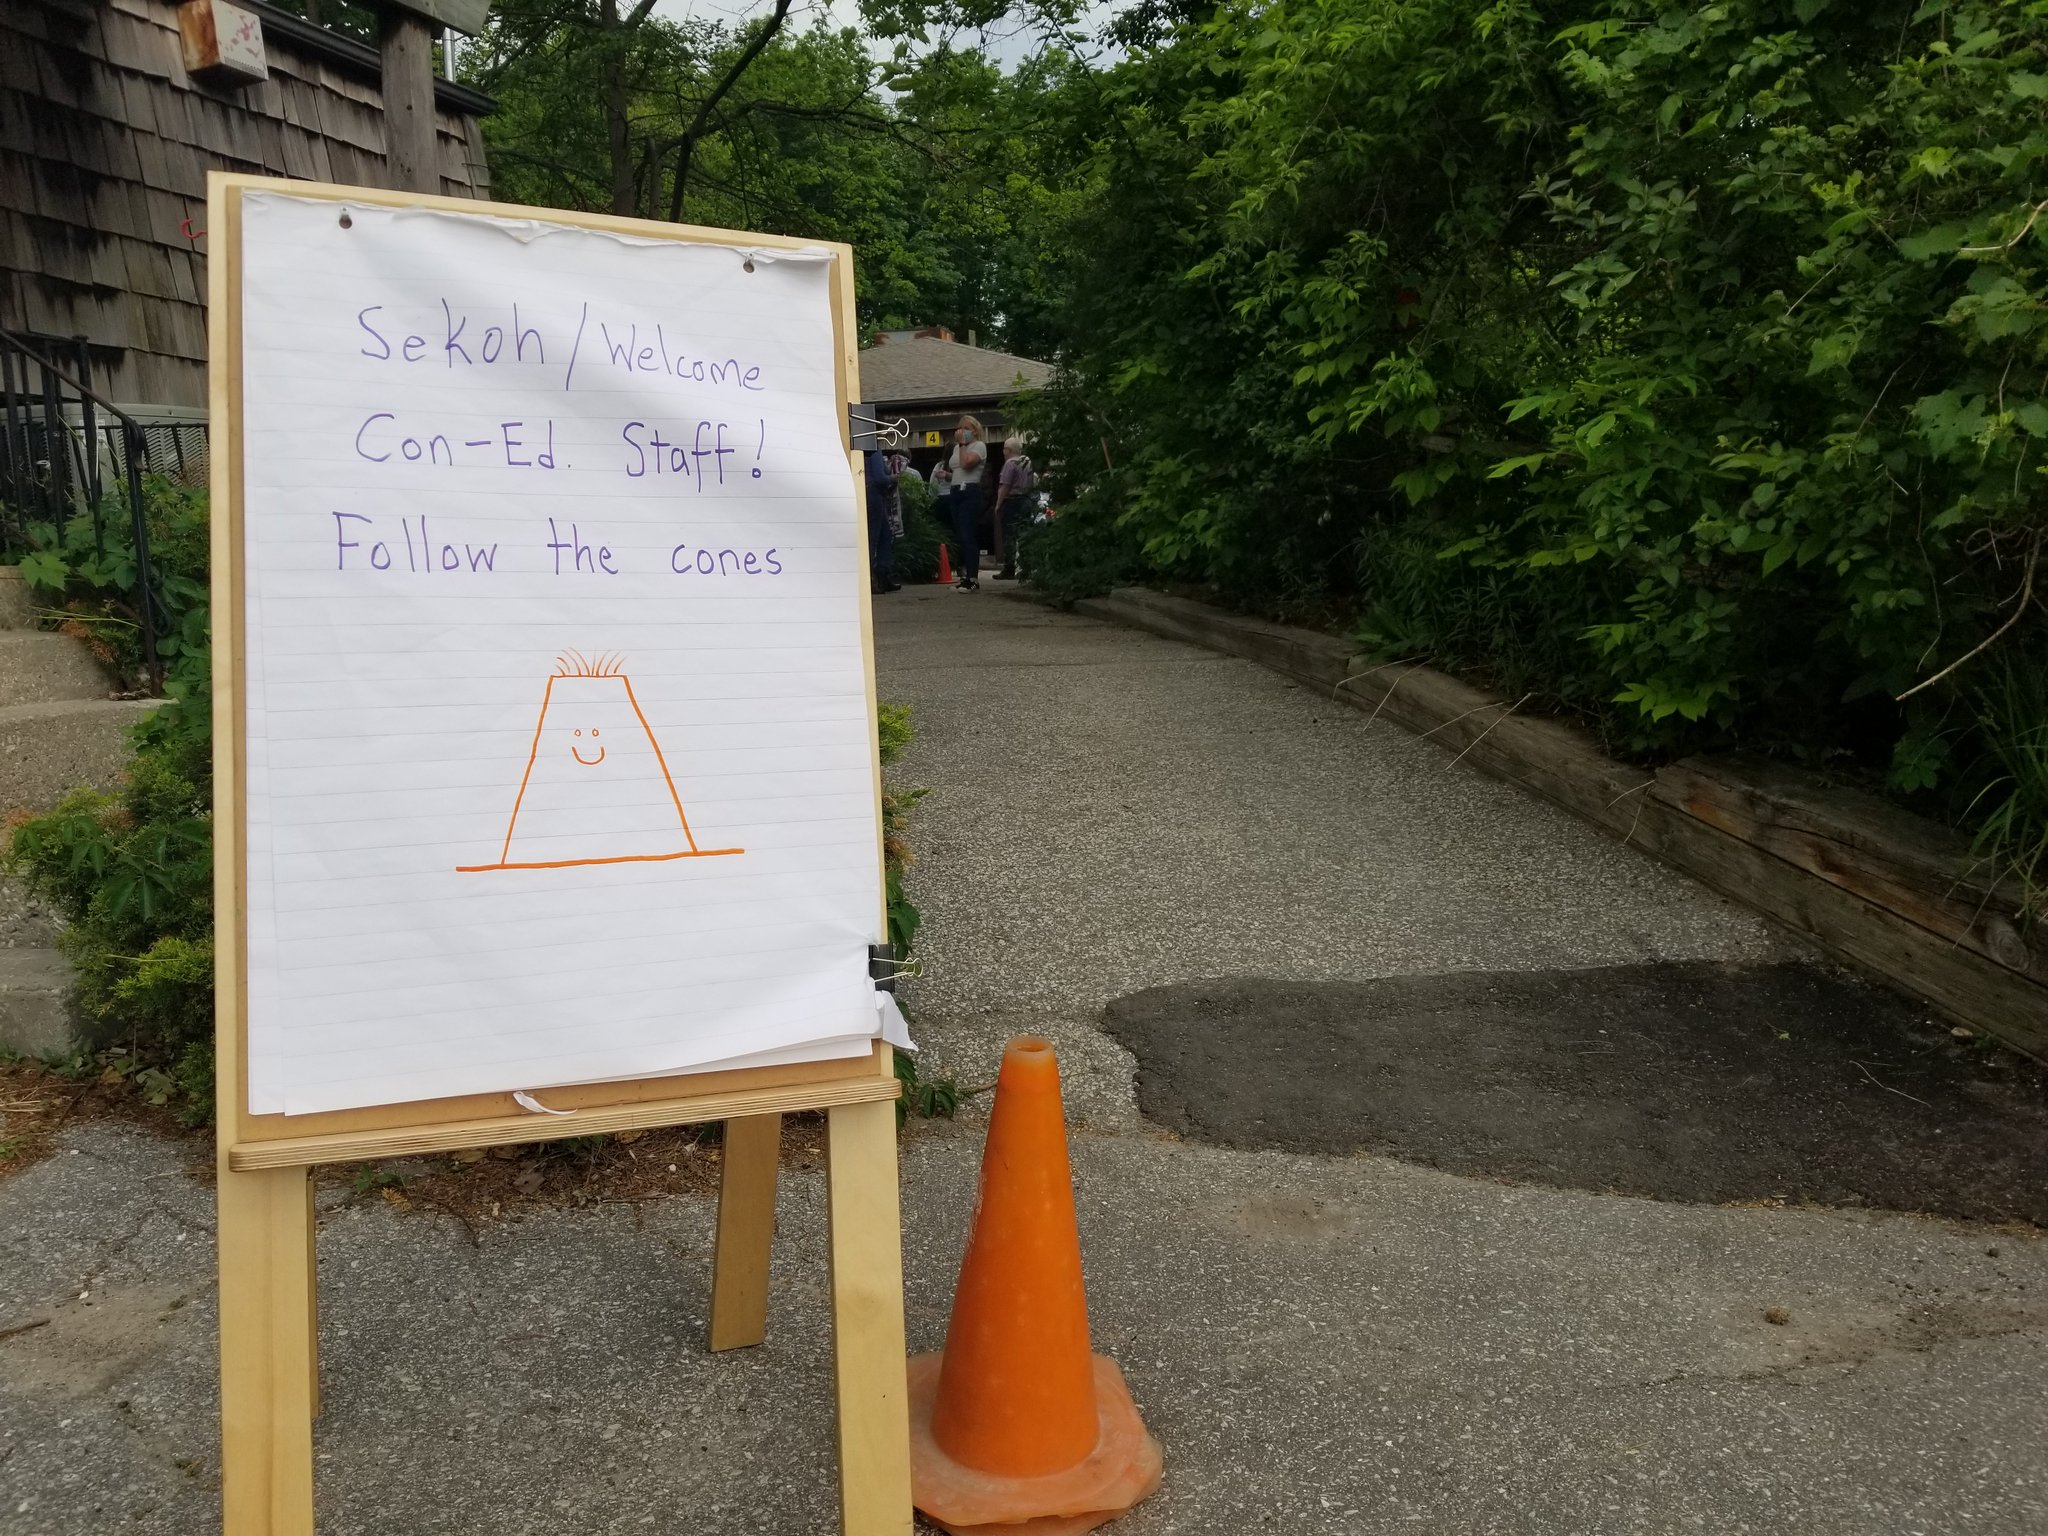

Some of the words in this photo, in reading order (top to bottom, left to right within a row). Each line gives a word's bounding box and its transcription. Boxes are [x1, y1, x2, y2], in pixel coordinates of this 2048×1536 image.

[355, 413, 572, 471] Con-Ed.
[622, 418, 766, 493] Staff!
[929, 433, 936, 443] 4
[332, 510, 498, 573] Follow
[546, 516, 619, 575] the
[671, 543, 783, 576] cones
